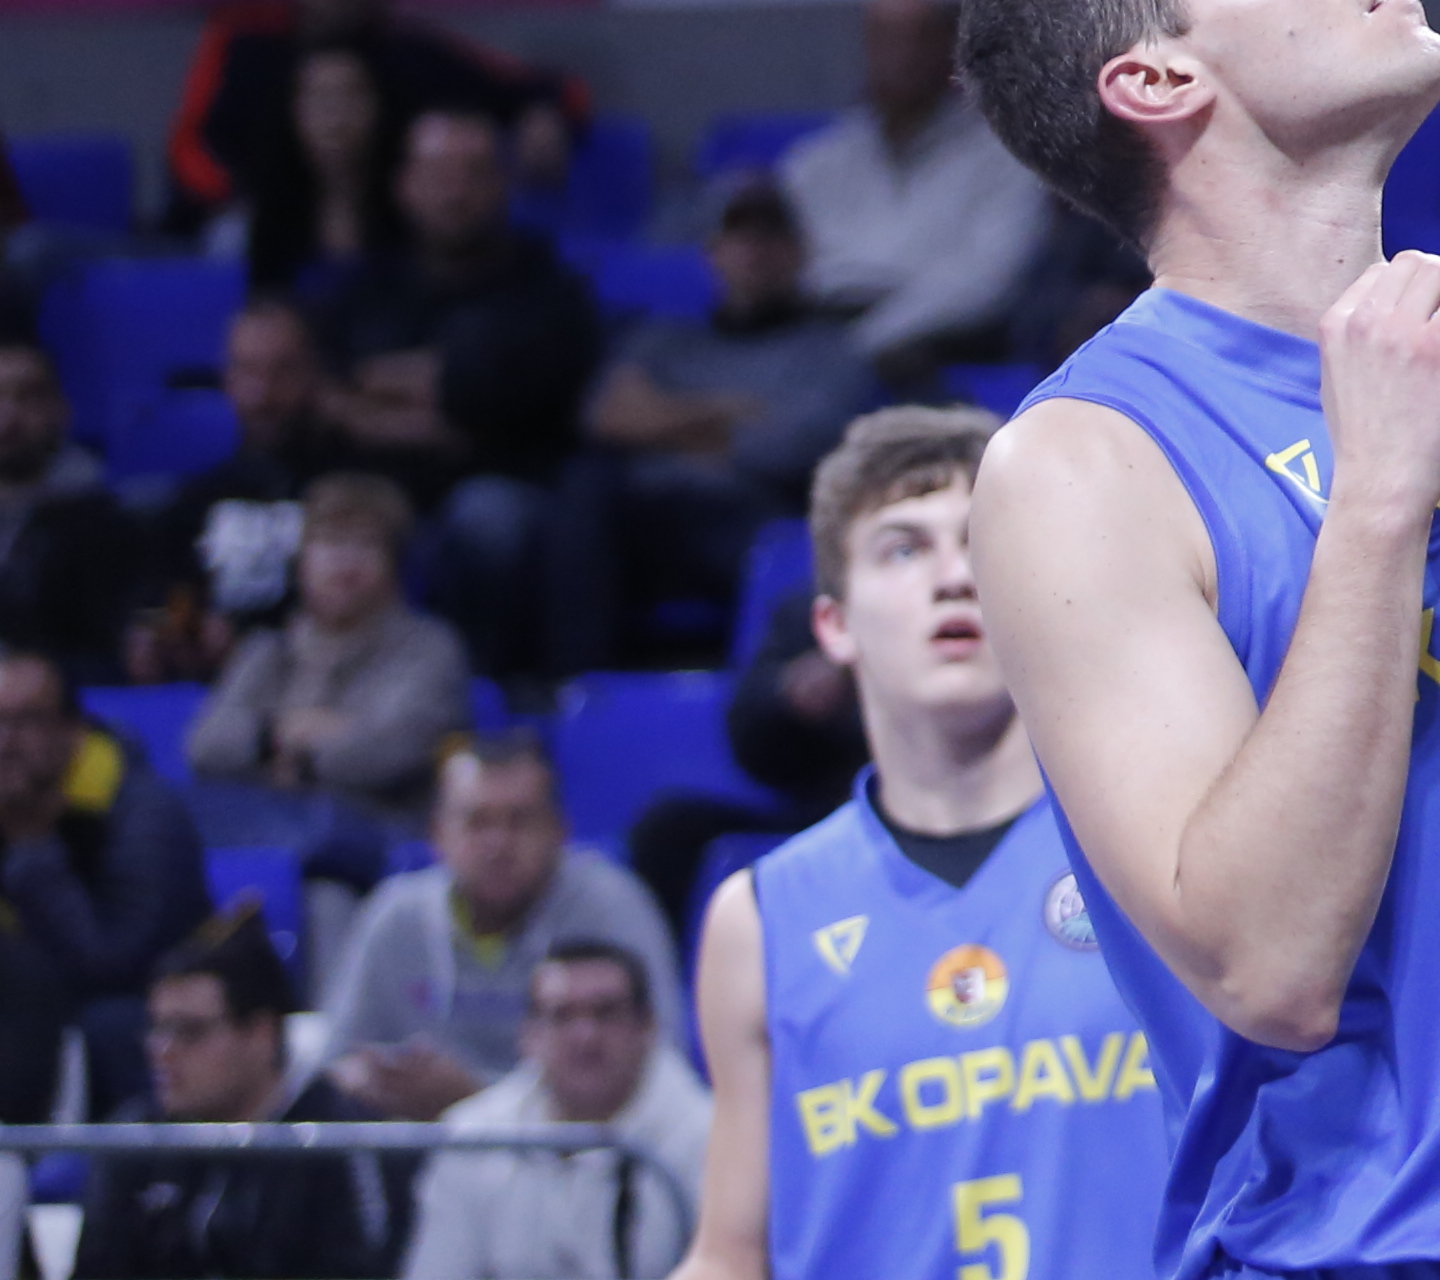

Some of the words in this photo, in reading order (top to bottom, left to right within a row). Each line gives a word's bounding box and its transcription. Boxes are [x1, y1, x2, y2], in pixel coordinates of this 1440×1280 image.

[796, 1067, 898, 1157] BK
[899, 1028, 1160, 1131] OPAVA
[952, 1173, 1031, 1280] 5
